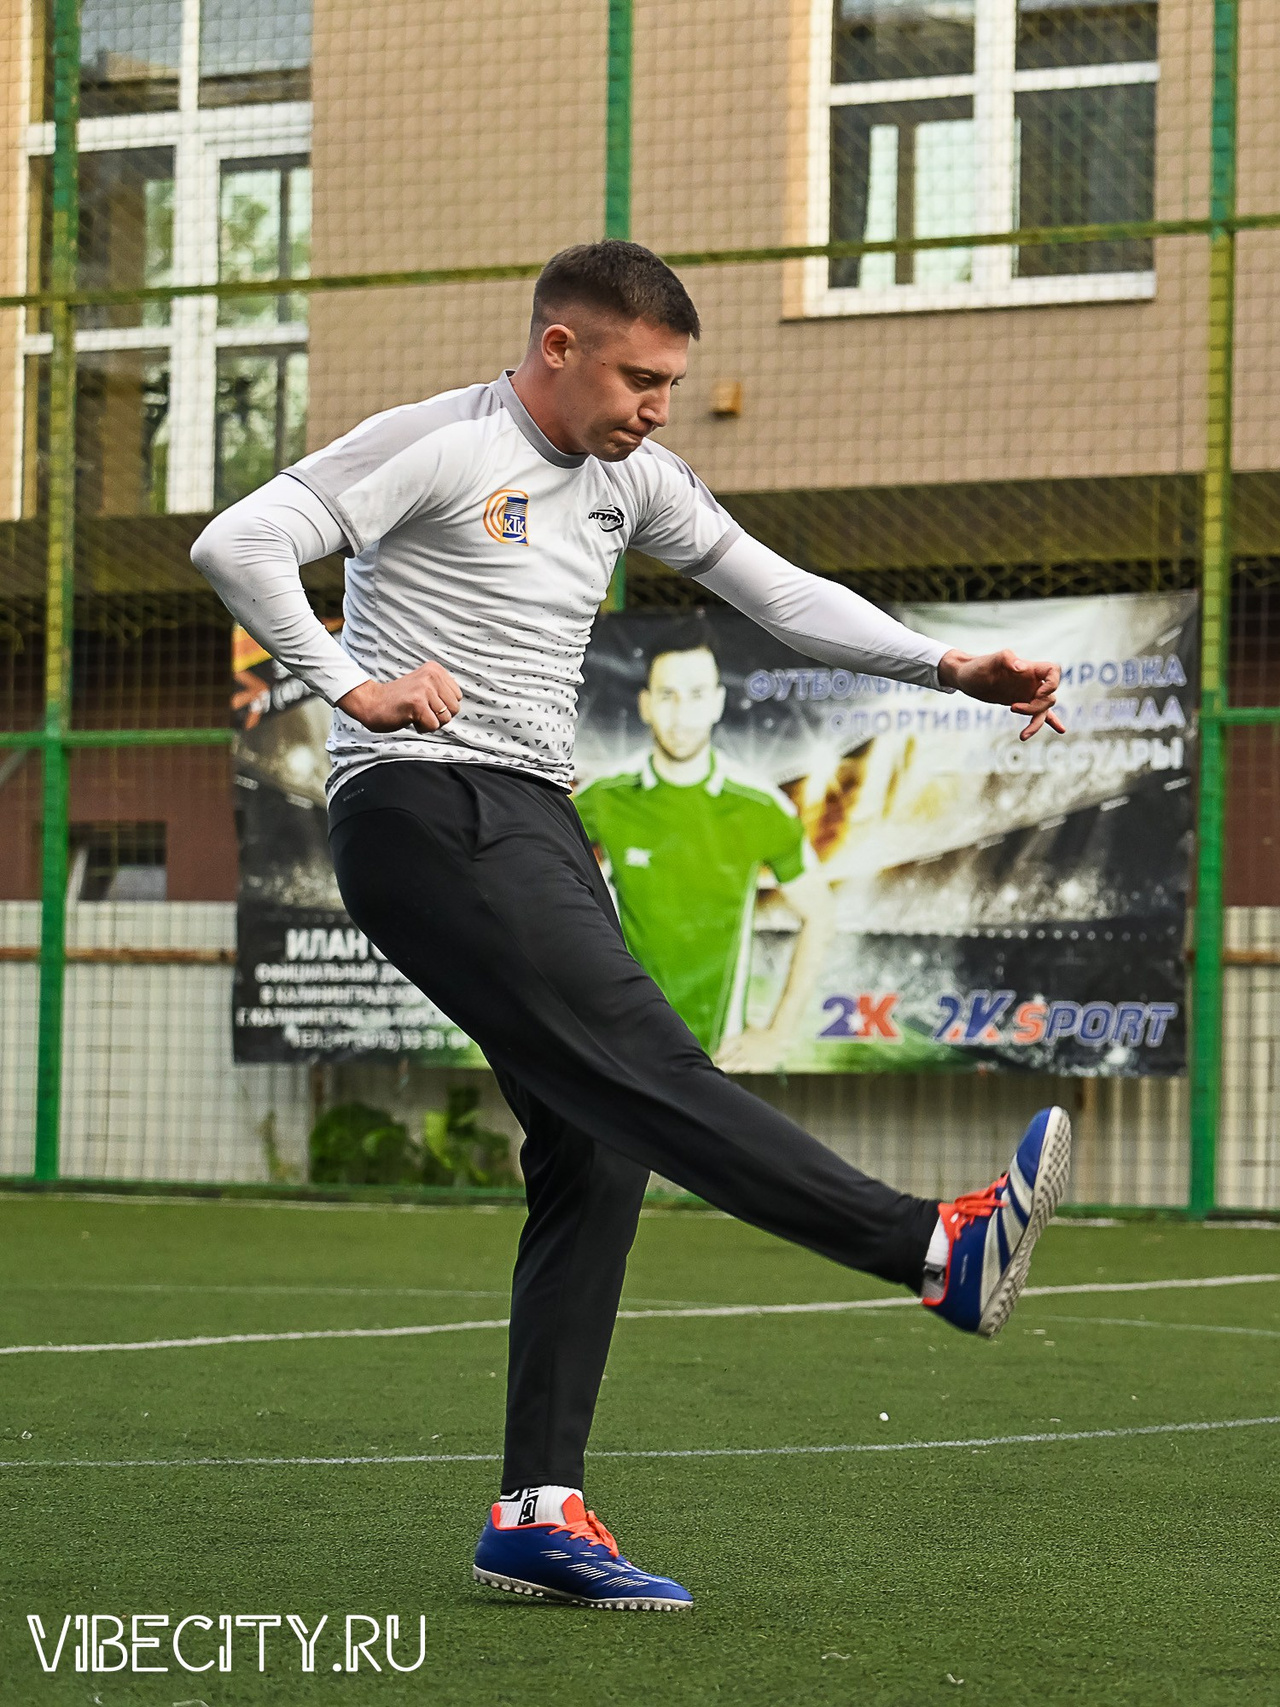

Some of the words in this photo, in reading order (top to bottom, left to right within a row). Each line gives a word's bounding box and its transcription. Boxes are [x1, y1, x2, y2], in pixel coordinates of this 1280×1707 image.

[746, 668, 927, 701] ФУТБОЛЬН
[828, 708, 1018, 736] СПОРТИВНА
[1011, 1001, 1180, 1046] SPORT
